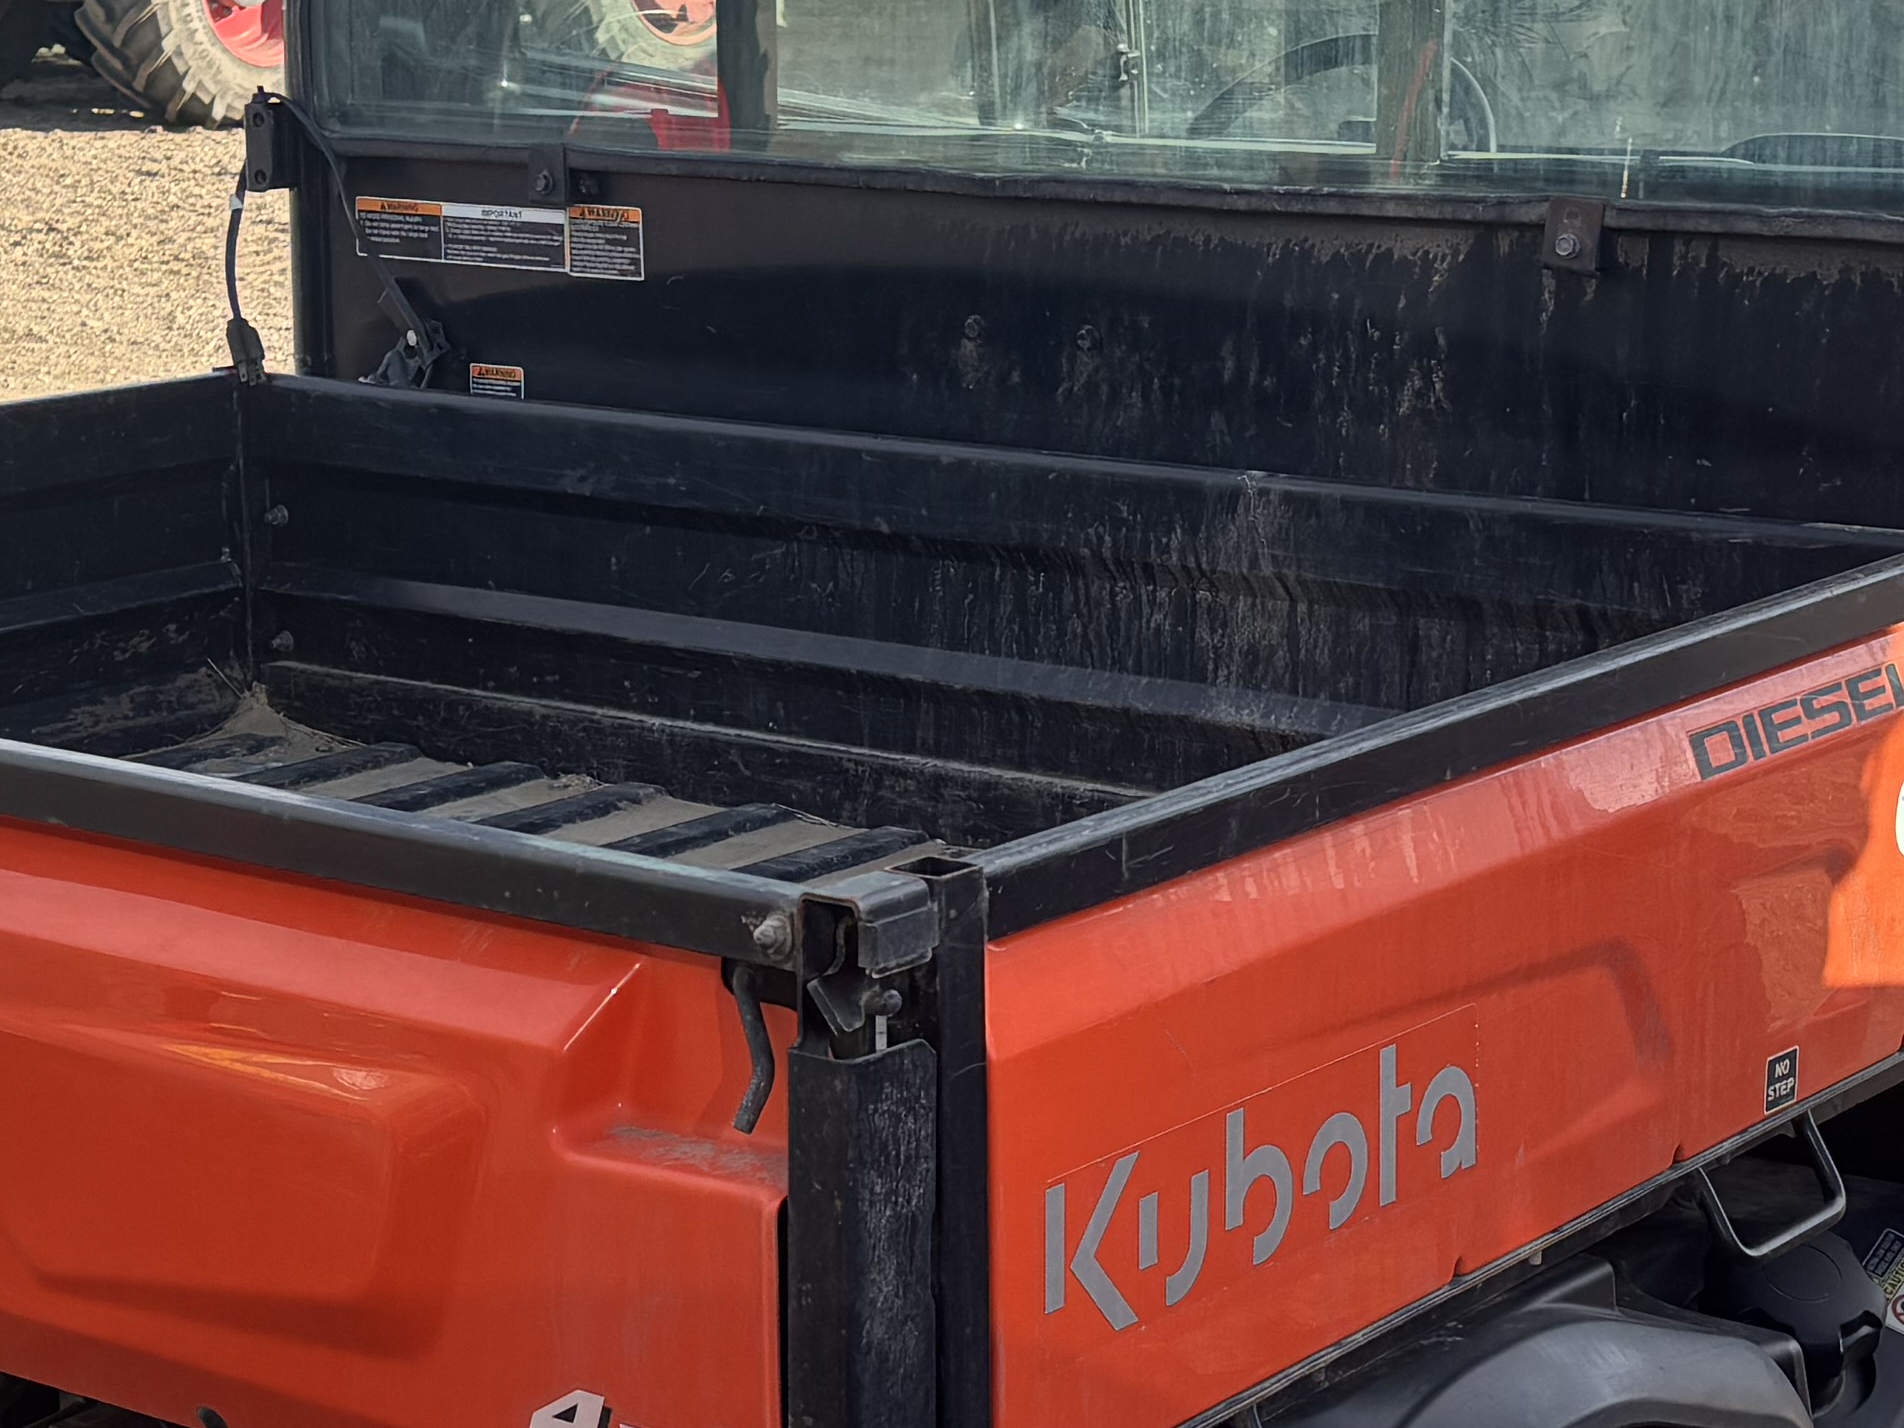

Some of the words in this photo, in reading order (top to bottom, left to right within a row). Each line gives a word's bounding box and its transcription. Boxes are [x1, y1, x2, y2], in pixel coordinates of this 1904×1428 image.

[1774, 1058, 1791, 1079] NO
[1767, 1076, 1795, 1102] STEP
[1043, 1043, 1477, 1331] Kubota
